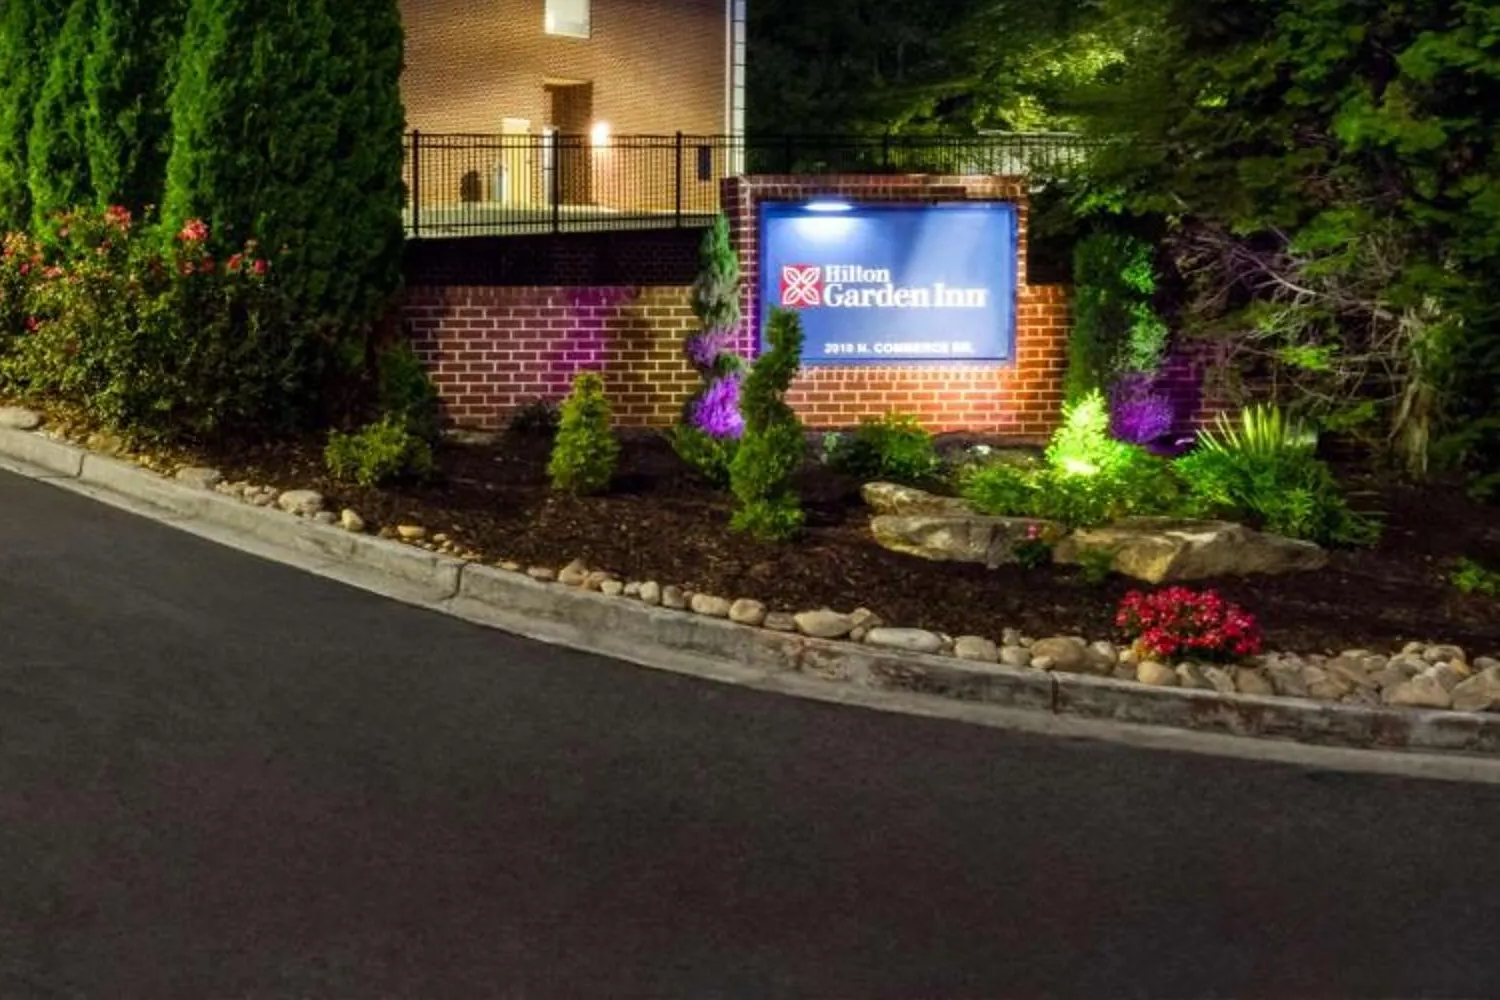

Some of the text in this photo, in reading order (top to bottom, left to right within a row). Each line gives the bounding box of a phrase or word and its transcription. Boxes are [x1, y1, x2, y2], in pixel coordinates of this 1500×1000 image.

[824, 265, 890, 283] Hilton
[824, 282, 987, 308] Garden Inn
[875, 342, 949, 354] COMC
